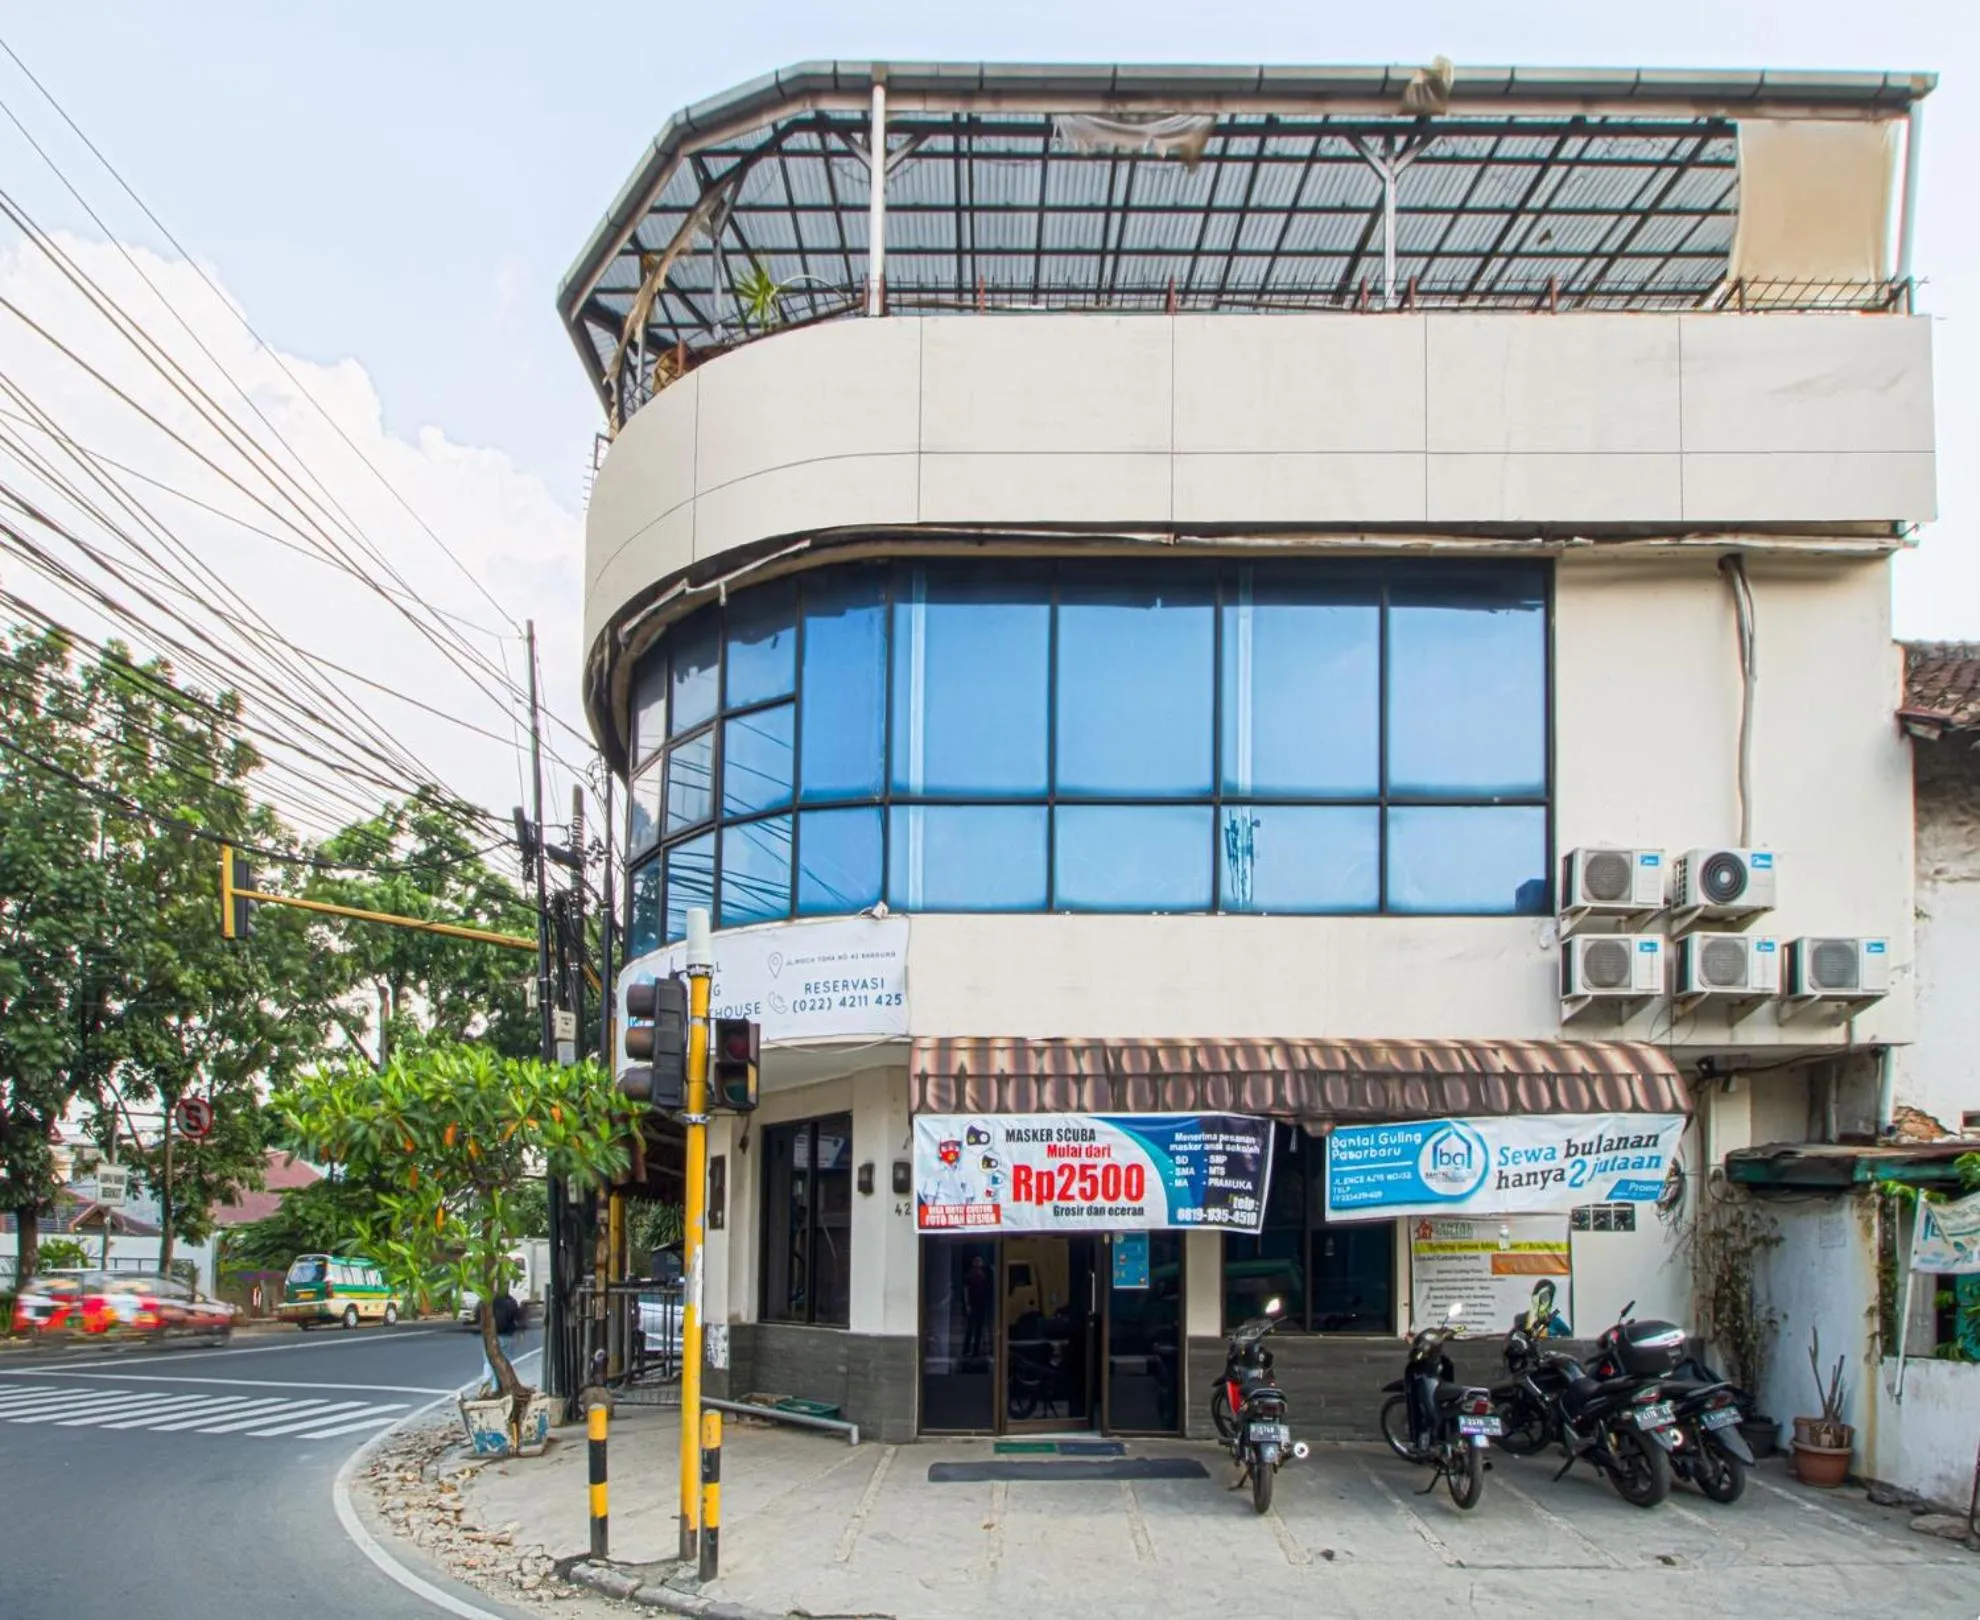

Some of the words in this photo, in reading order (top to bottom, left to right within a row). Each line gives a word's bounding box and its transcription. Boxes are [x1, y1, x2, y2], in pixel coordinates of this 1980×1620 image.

[804, 977, 885, 994] RESERVASI
[793, 997, 832, 1013] (022)
[839, 995, 868, 1008] 4211
[874, 993, 902, 1006] 425
[1005, 1128, 1053, 1142] MASKER
[1056, 1128, 1096, 1142] SCUBA
[1175, 1132, 1217, 1142] Menerima
[1331, 1134, 1375, 1149] Bantal
[1379, 1131, 1422, 1145] Guling
[1047, 1144, 1082, 1158] Mulai
[1085, 1144, 1111, 1158] dari
[1332, 1146, 1402, 1160] Pasarbaru
[1498, 1145, 1557, 1167] Sewa
[1564, 1134, 1659, 1158] bulanan
[1496, 1167, 1565, 1190] hanya
[1568, 1158, 1588, 1188] 2
[1588, 1155, 1662, 1181] jutaan
[1012, 1163, 1145, 1206] Rp2500
[1208, 1178, 1253, 1190] PRAMUKA
[895, 1202, 911, 1216] 42
[1053, 1205, 1084, 1217] Grosir
[1087, 1205, 1105, 1216] dan
[1108, 1206, 1144, 1216] eceran
